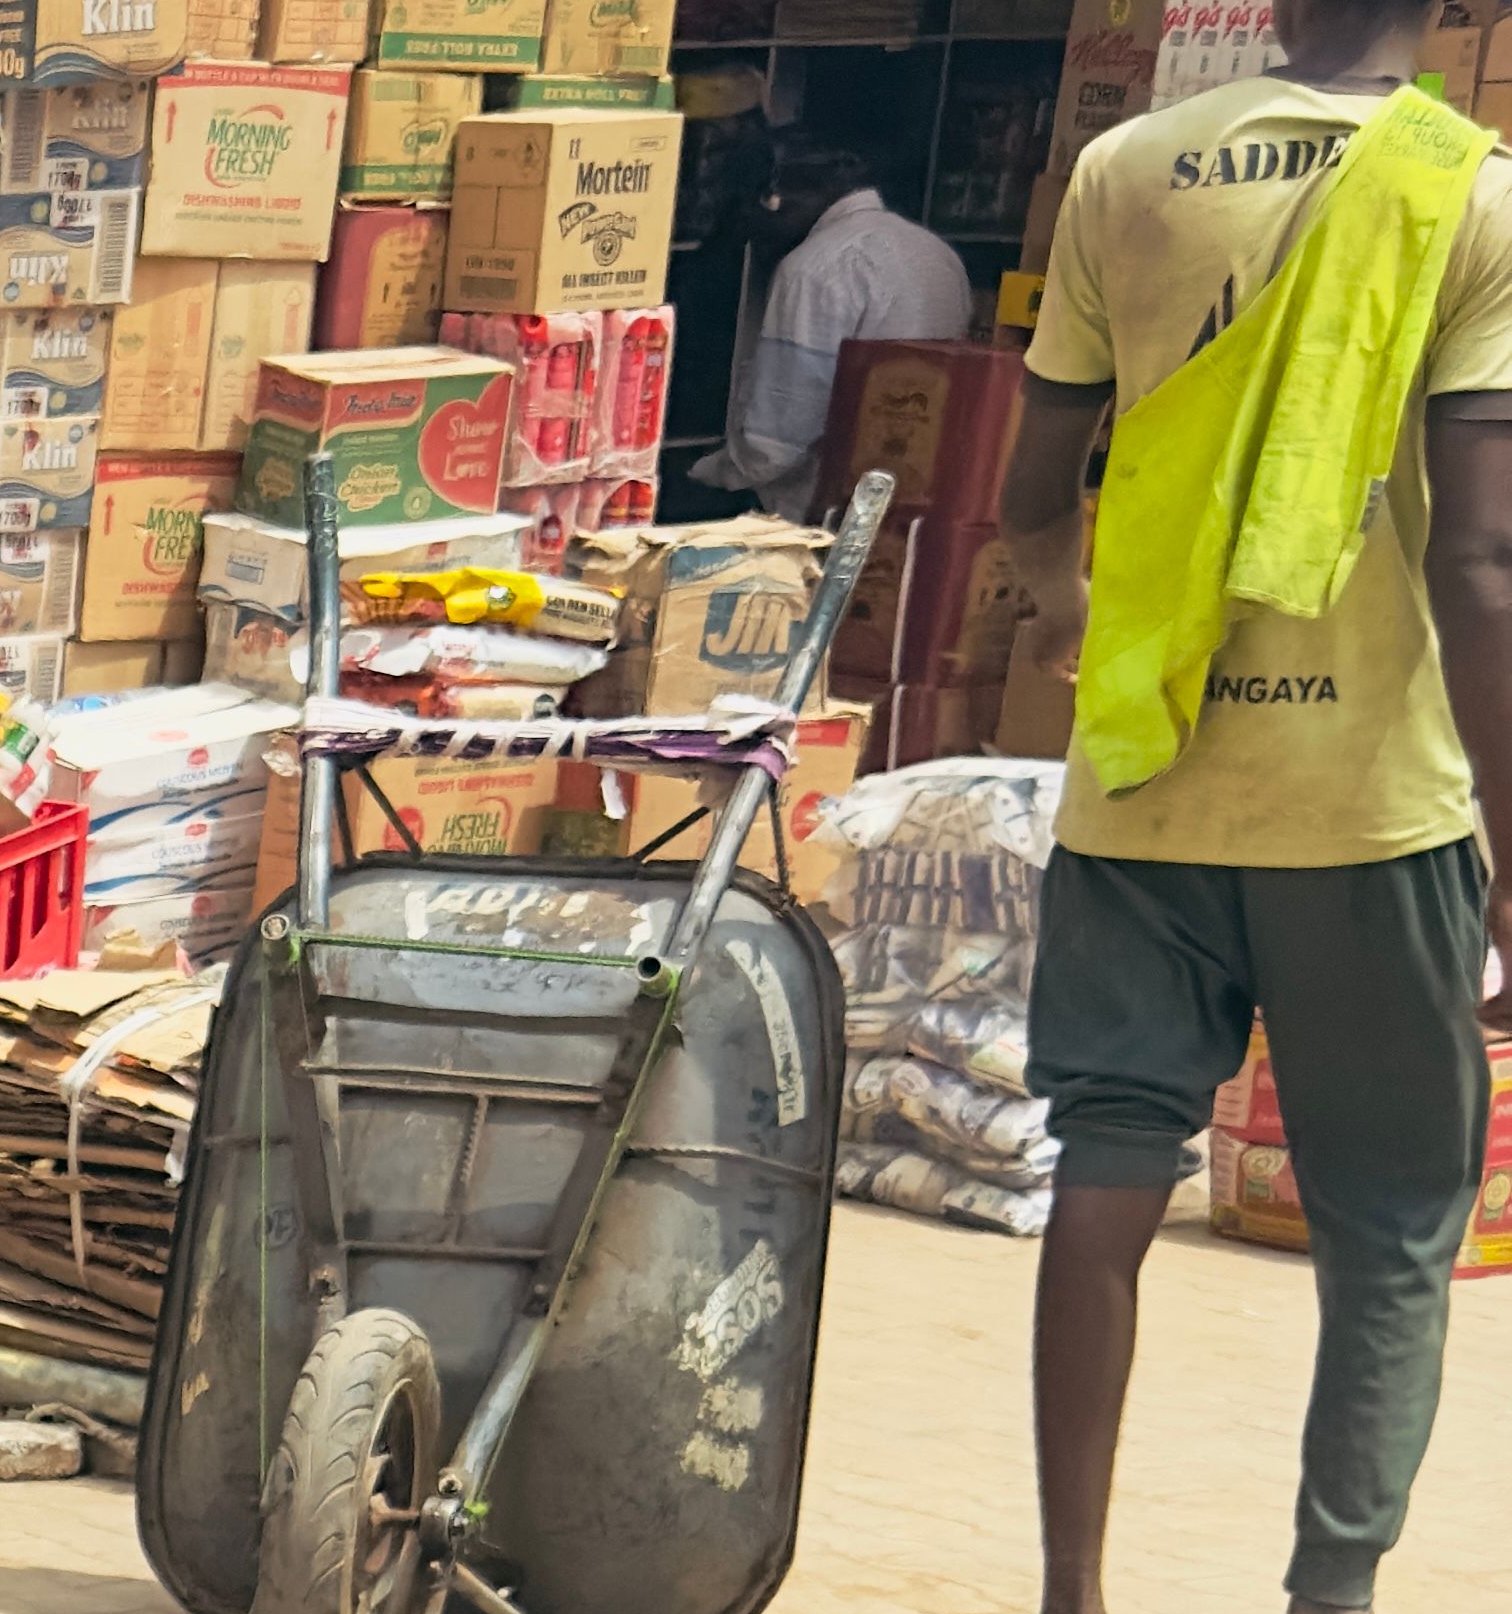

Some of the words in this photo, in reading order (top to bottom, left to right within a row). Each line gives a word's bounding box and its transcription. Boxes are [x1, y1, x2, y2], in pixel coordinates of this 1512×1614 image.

[207, 118, 293, 151] MORNING
[215, 148, 276, 176] FRESH
[576, 158, 652, 197] Mortein
[32, 328, 88, 360] Klin
[23, 440, 77, 471] Klin
[146, 507, 198, 535] MORN
[154, 535, 194, 562] FRE
[443, 813, 501, 840] FRESH
